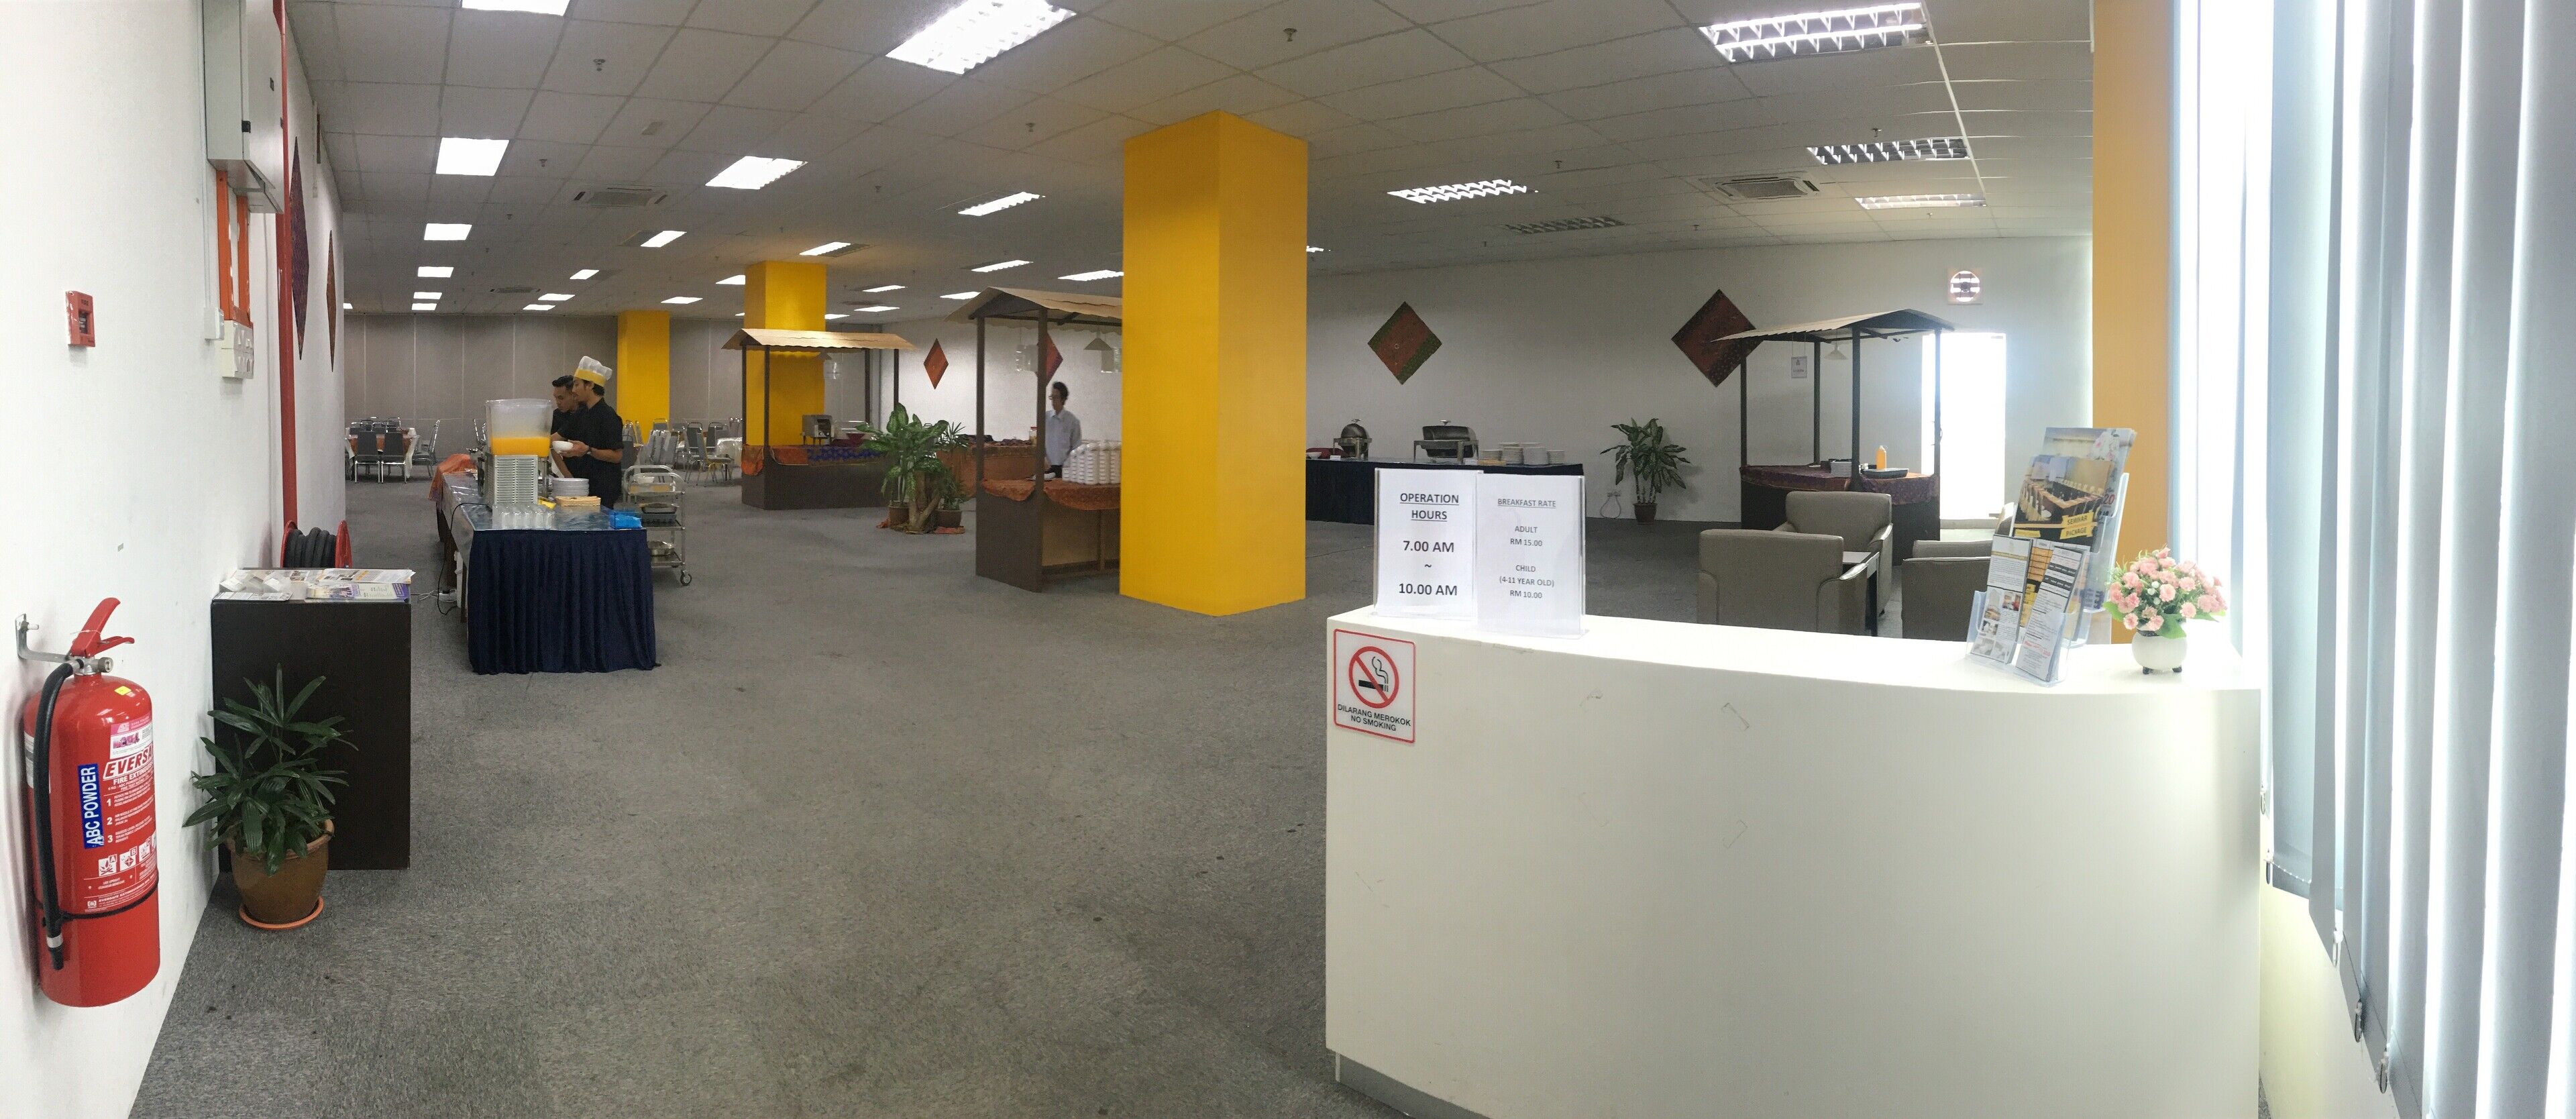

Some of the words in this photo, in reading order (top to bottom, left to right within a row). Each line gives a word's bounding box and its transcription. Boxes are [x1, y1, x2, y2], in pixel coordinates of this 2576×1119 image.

[1400, 493, 1459, 505] OPERATION
[1497, 498, 1536, 508] BREAKFAST
[1538, 500, 1556, 509] RATE
[1411, 510, 1447, 521] HOURS
[1403, 540, 1429, 551] 7.00
[1432, 541, 1454, 553] AM
[1499, 576, 1515, 584] (4-11
[1537, 579, 1555, 588] OLD)
[1399, 583, 1432, 596] 10.00
[1435, 584, 1458, 596] AM
[1338, 704, 1373, 718] DILARANG
[1374, 712, 1411, 727] MEROKOK
[1351, 715, 1362, 723] NO
[1363, 717, 1397, 731] SMOKING
[113, 775, 128, 786] FIRE
[80, 766, 99, 819] POWDER
[107, 798, 111, 807] 1
[107, 816, 113, 826] 2
[85, 820, 101, 845] ABC
[107, 835, 113, 843] 3
[131, 848, 137, 857] B
[110, 855, 116, 863] A
